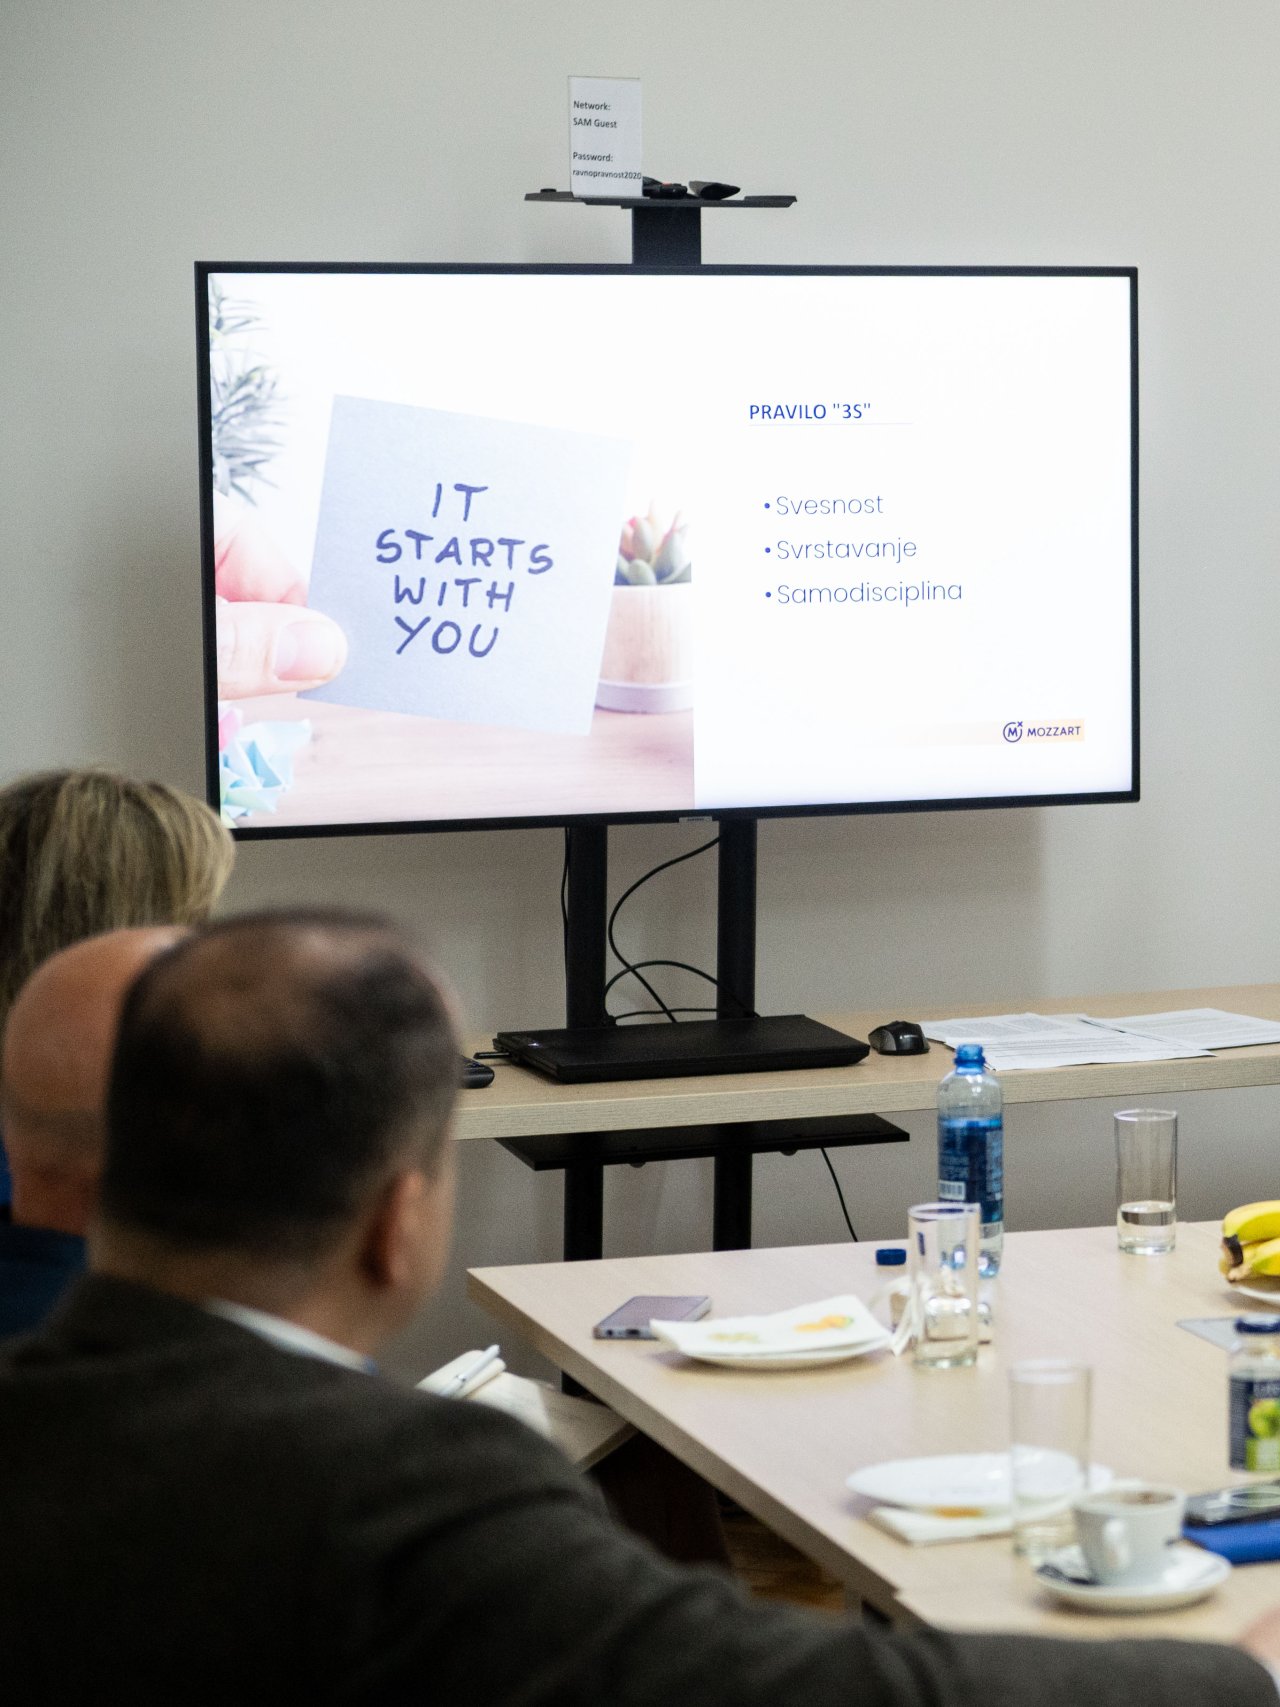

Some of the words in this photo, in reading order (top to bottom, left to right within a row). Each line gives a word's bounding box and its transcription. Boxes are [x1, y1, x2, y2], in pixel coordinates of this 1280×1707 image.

[573, 100, 611, 110] Network:
[573, 117, 592, 127] SAM
[594, 118, 617, 129] Guest
[573, 151, 613, 162] Password:
[749, 403, 828, 421] PRAVILO
[832, 402, 872, 421] "3S"
[431, 482, 489, 522] IT
[775, 495, 884, 516] Svesnost
[375, 528, 555, 576] STARTS
[776, 537, 918, 564] Svrstavanje
[394, 575, 516, 612] WITH
[776, 580, 963, 607] Samodisciplina
[394, 615, 500, 659] YOU
[1027, 726, 1081, 737] MOZZART
